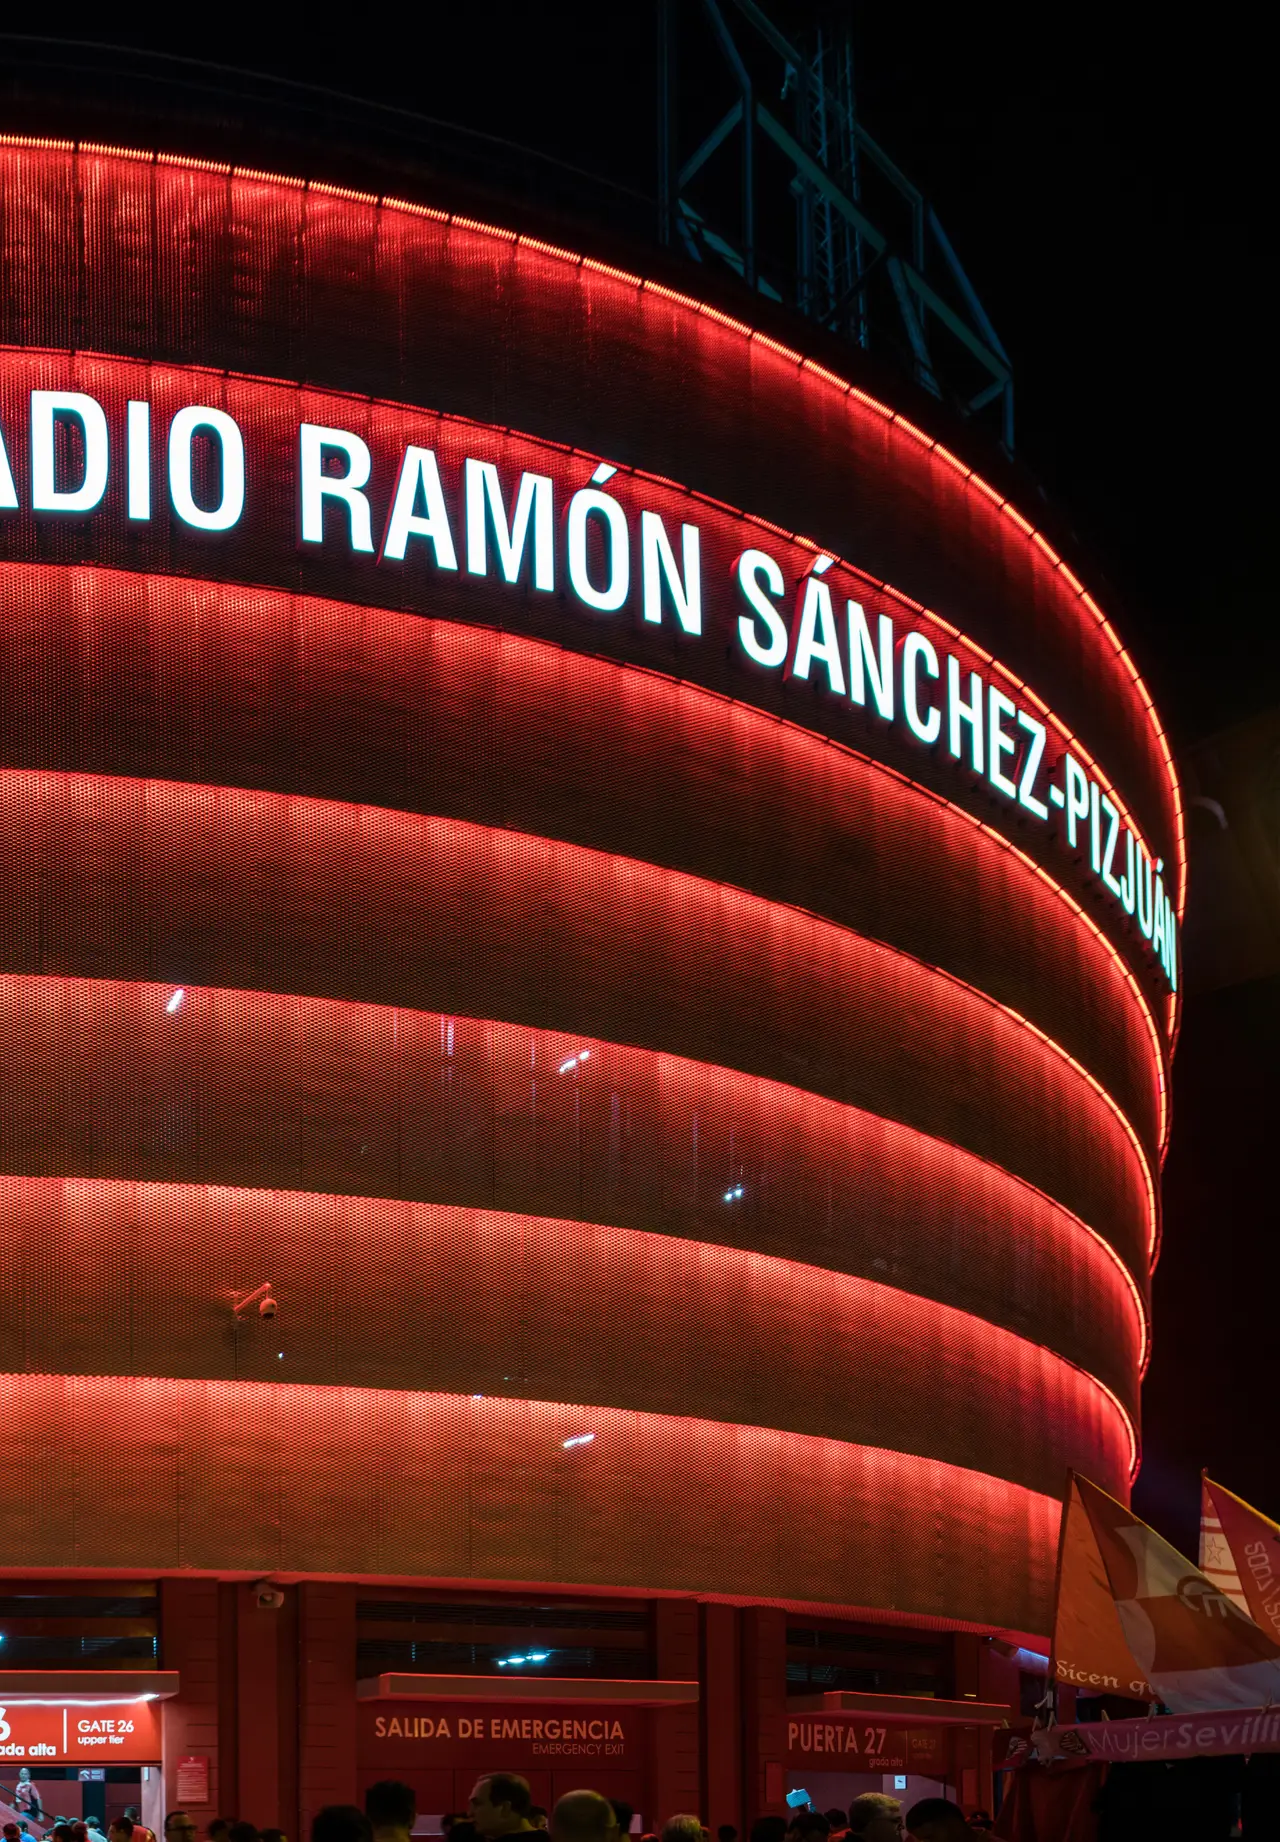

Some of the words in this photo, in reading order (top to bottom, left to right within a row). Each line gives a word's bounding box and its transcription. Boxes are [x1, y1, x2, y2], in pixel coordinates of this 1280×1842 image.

[300, 422, 702, 636] RAMÓN
[738, 549, 1177, 992] SÁNCHEZ-PIZJUÁN
[77, 1720, 114, 1733] GATE
[117, 1720, 134, 1733] 26
[375, 1717, 451, 1738] SALIDA
[458, 1719, 484, 1738] DE
[491, 1719, 624, 1740] EMERGENCIA
[77, 1735, 106, 1745] upper
[108, 1734, 124, 1744] tier
[788, 1723, 858, 1753] PUERTA
[864, 1728, 887, 1754] 27
[28, 1743, 56, 1757] alta
[532, 1743, 602, 1755] EMERGENCY
[605, 1744, 624, 1755] EXIT
[869, 1757, 889, 1768] grada
[890, 1757, 903, 1767] alta
